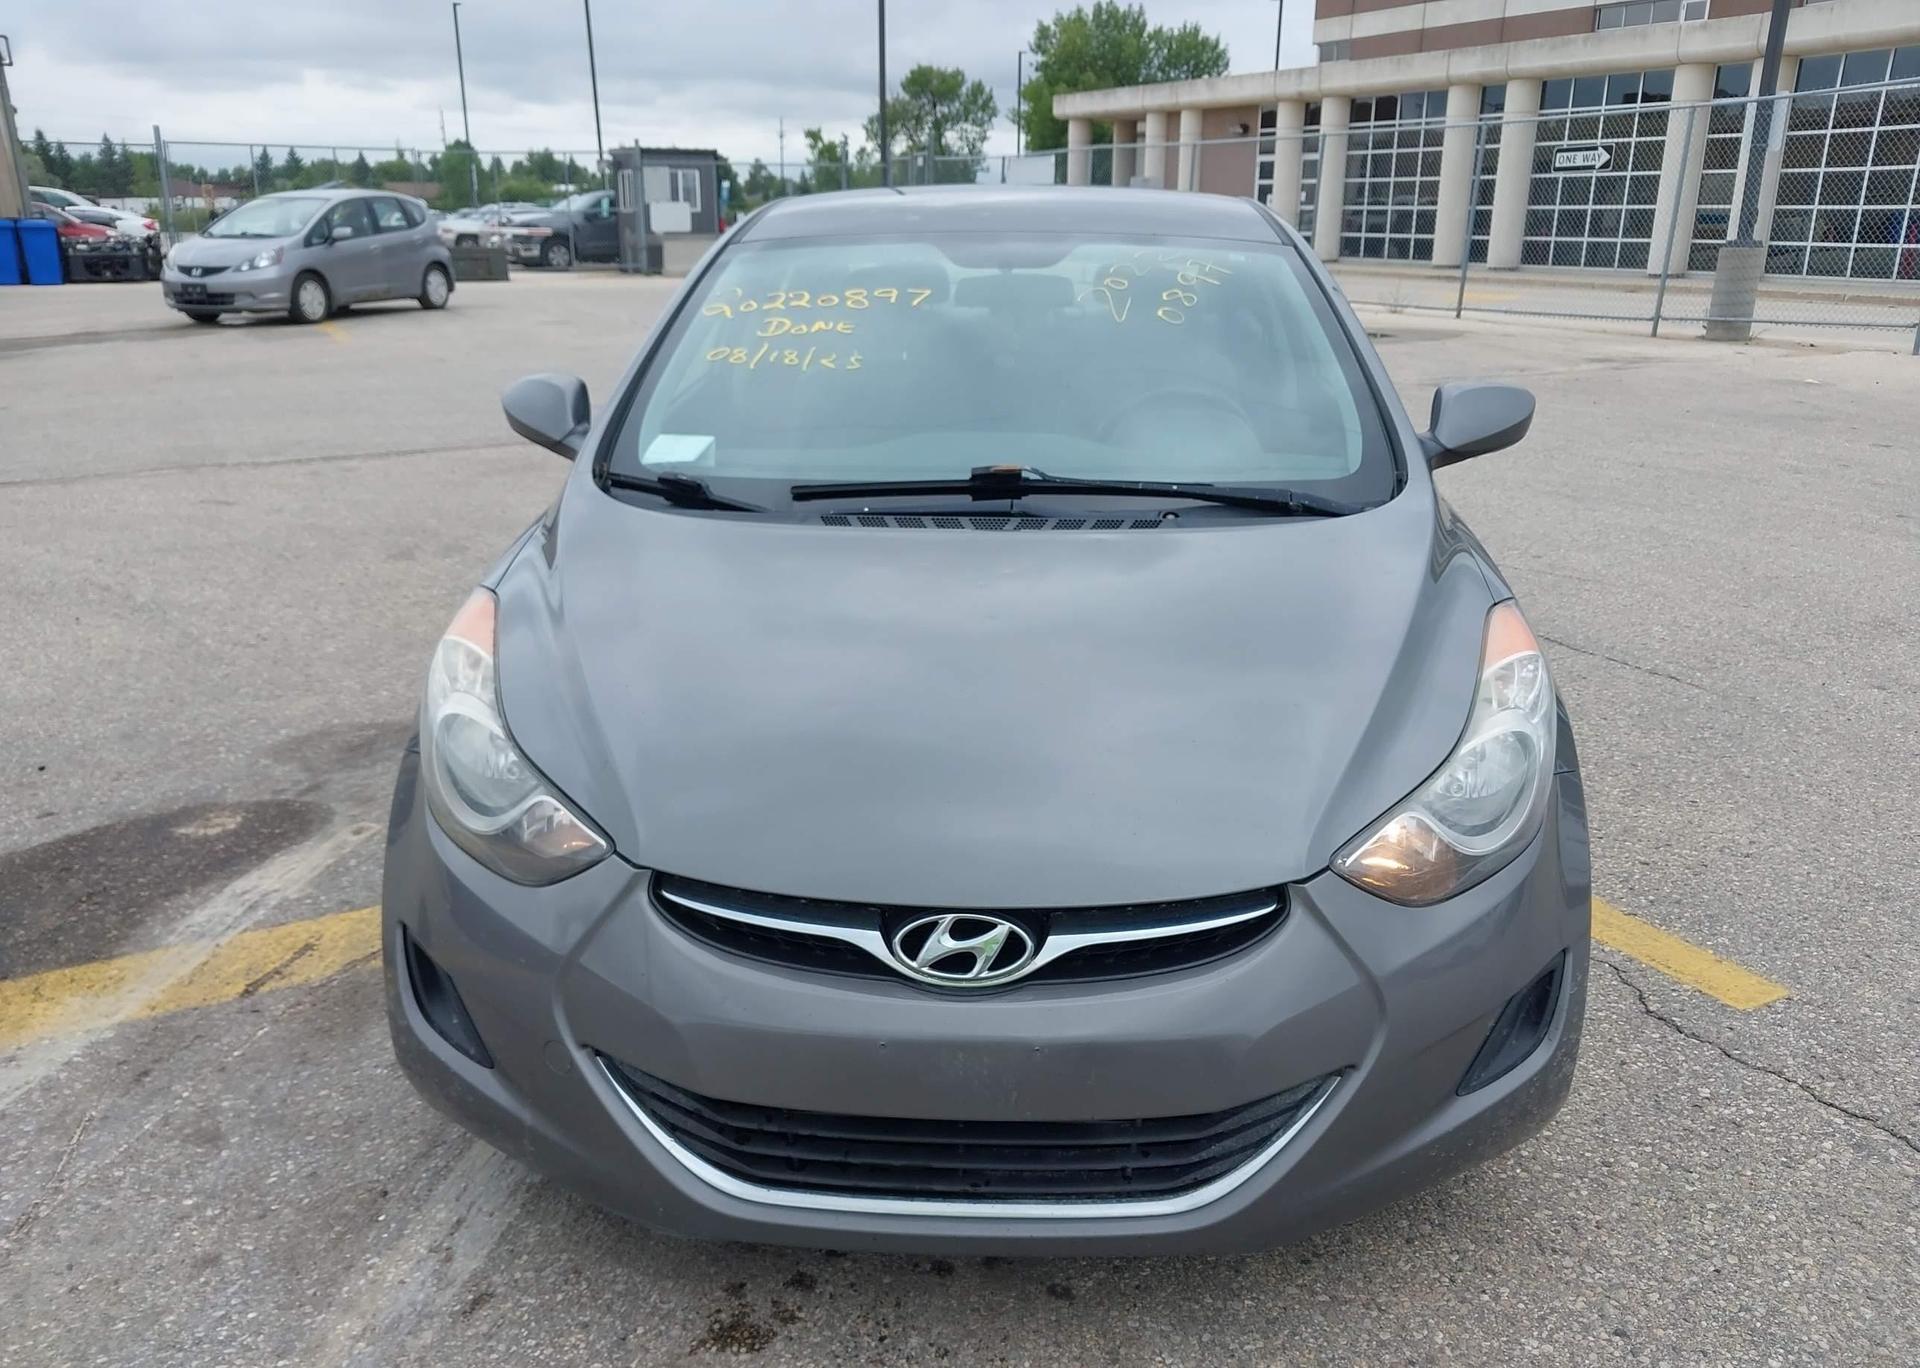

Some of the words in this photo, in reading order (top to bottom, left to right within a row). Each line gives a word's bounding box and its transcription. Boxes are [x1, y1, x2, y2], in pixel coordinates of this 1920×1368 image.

[1558, 153, 1578, 165] ONE
[1582, 151, 1603, 163] WAY
[703, 287, 932, 319] 20220897
